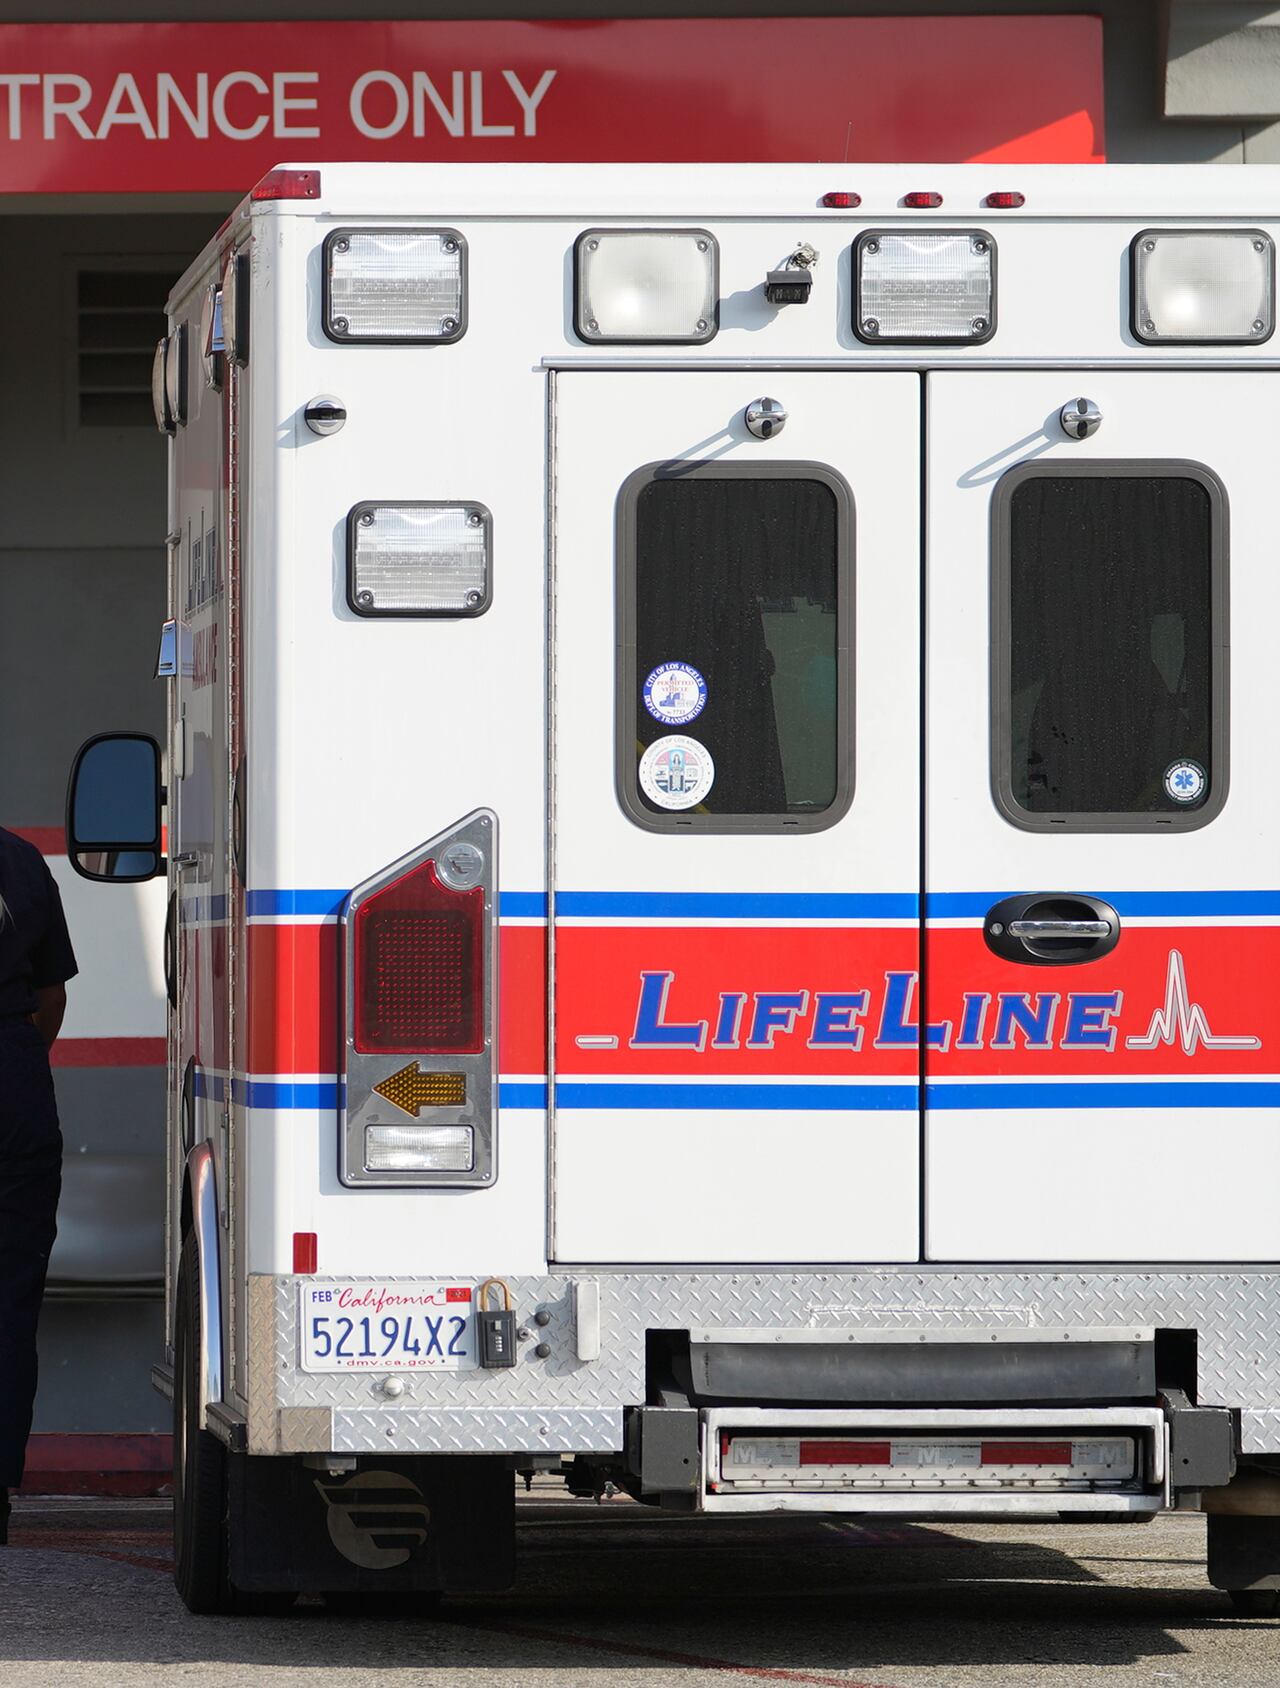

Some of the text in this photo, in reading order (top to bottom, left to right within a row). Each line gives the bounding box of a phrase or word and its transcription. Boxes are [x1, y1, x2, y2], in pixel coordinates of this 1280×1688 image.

[349, 69, 557, 139] ONLY
[646, 662, 704, 687] CITY OF LOS ANGELES
[660, 693, 706, 724] TRANSPORTATION
[311, 1290, 333, 1303] FEB
[338, 1287, 447, 1313] California
[312, 1315, 468, 1358] 52194X2
[346, 1359, 437, 1368] dmv.ca.gov
